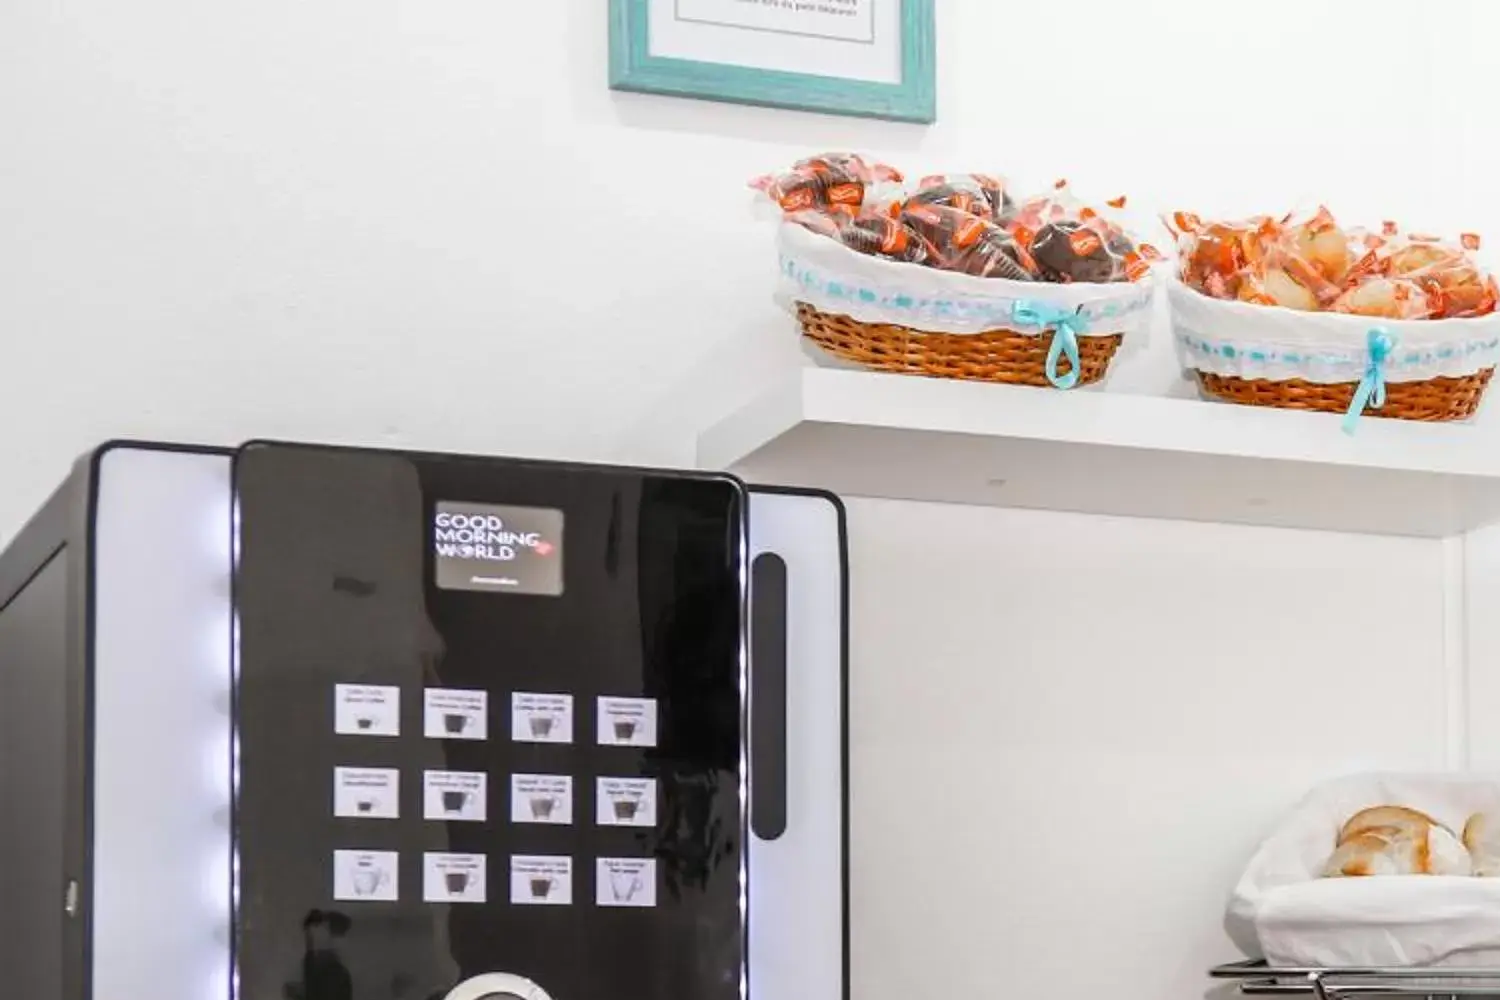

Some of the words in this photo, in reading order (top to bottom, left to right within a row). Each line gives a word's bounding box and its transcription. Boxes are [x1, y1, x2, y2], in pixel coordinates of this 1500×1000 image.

[436, 513, 502, 530] GOOD
[436, 528, 541, 546] MORNING
[436, 543, 515, 560] WORLD
